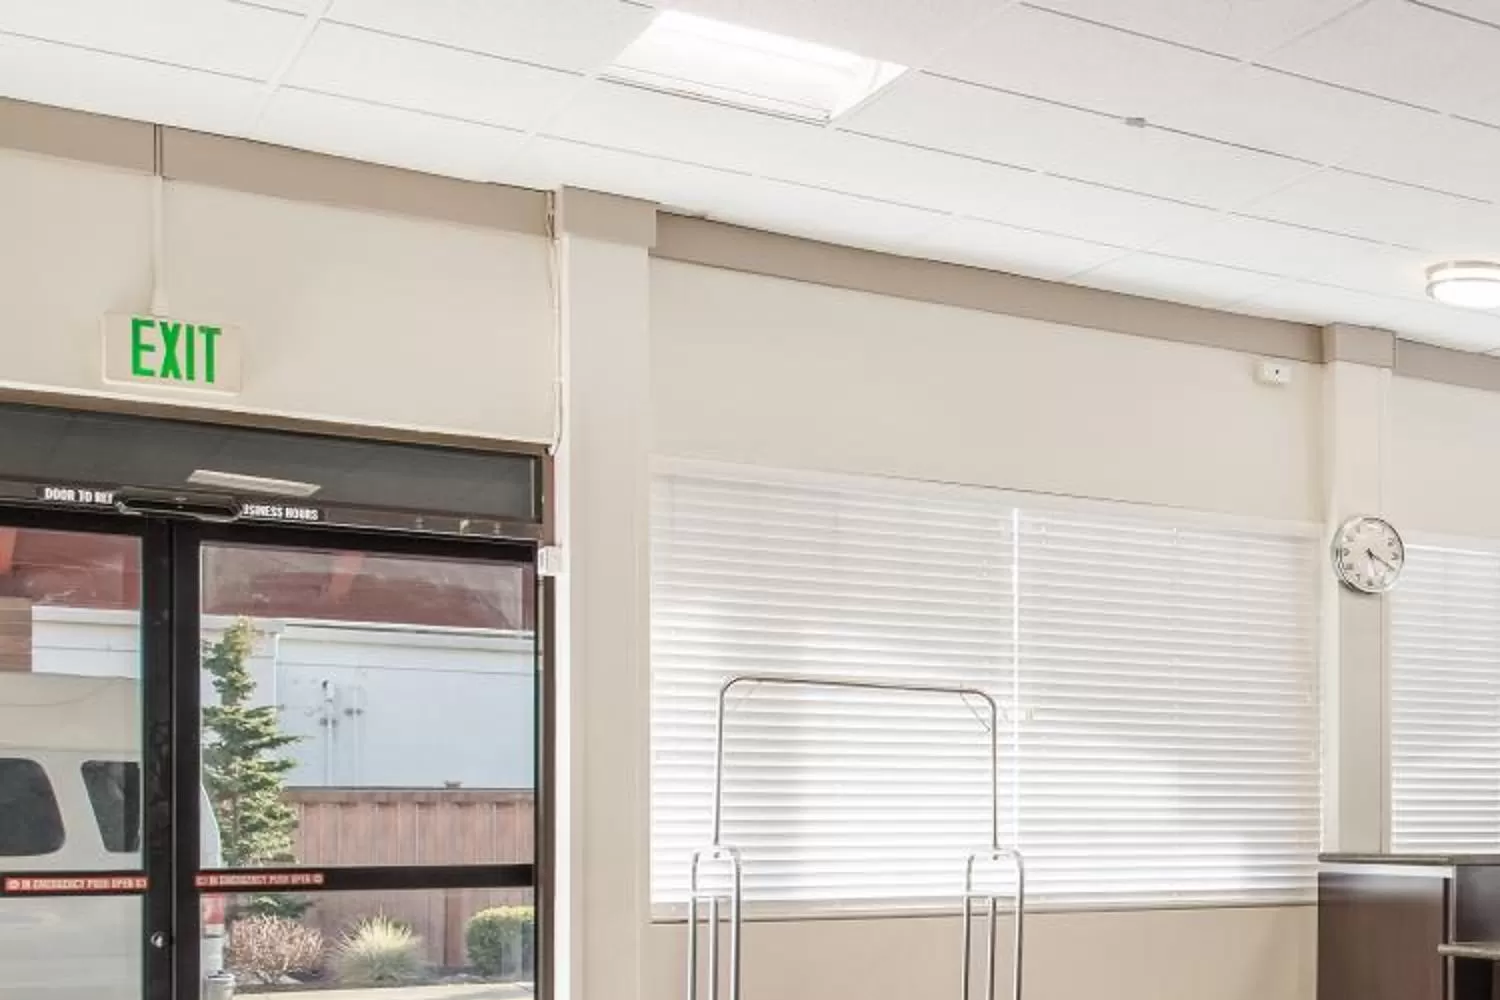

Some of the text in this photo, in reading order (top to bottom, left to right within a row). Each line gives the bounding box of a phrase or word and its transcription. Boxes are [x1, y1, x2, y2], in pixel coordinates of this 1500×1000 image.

[131, 317, 223, 384] EXIT
[44, 487, 76, 502] DOOR
[78, 489, 93, 503] TO
[285, 507, 319, 521] HOURS
